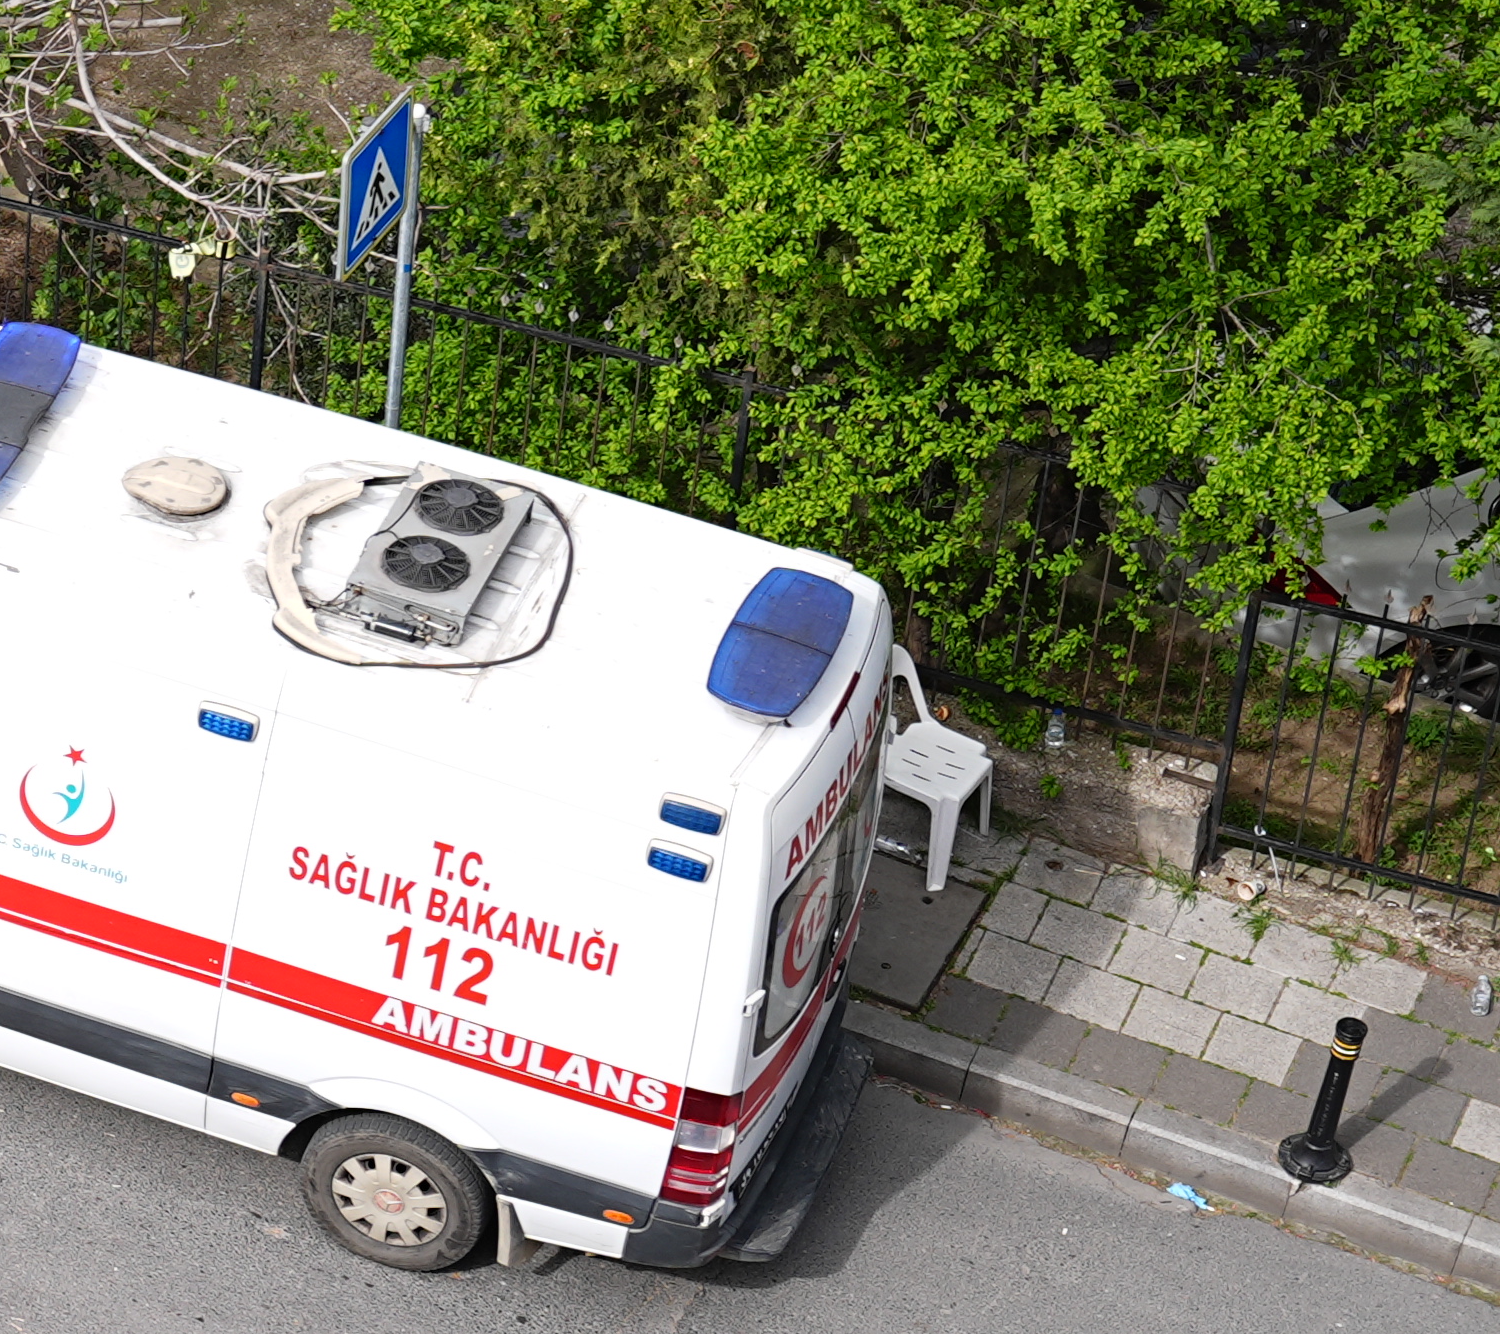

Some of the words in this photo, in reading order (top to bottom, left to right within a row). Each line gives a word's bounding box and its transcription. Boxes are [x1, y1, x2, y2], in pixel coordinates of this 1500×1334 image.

[12, 838, 56, 861] Sağlık
[60, 853, 129, 885] Bakanlığı
[432, 840, 492, 892] T.C.
[288, 845, 418, 915] SAĞLIK
[424, 887, 620, 978] BAKANLIĞI
[794, 891, 829, 960] 112
[383, 925, 497, 1009] 112
[371, 996, 669, 1113] AMBULANS
